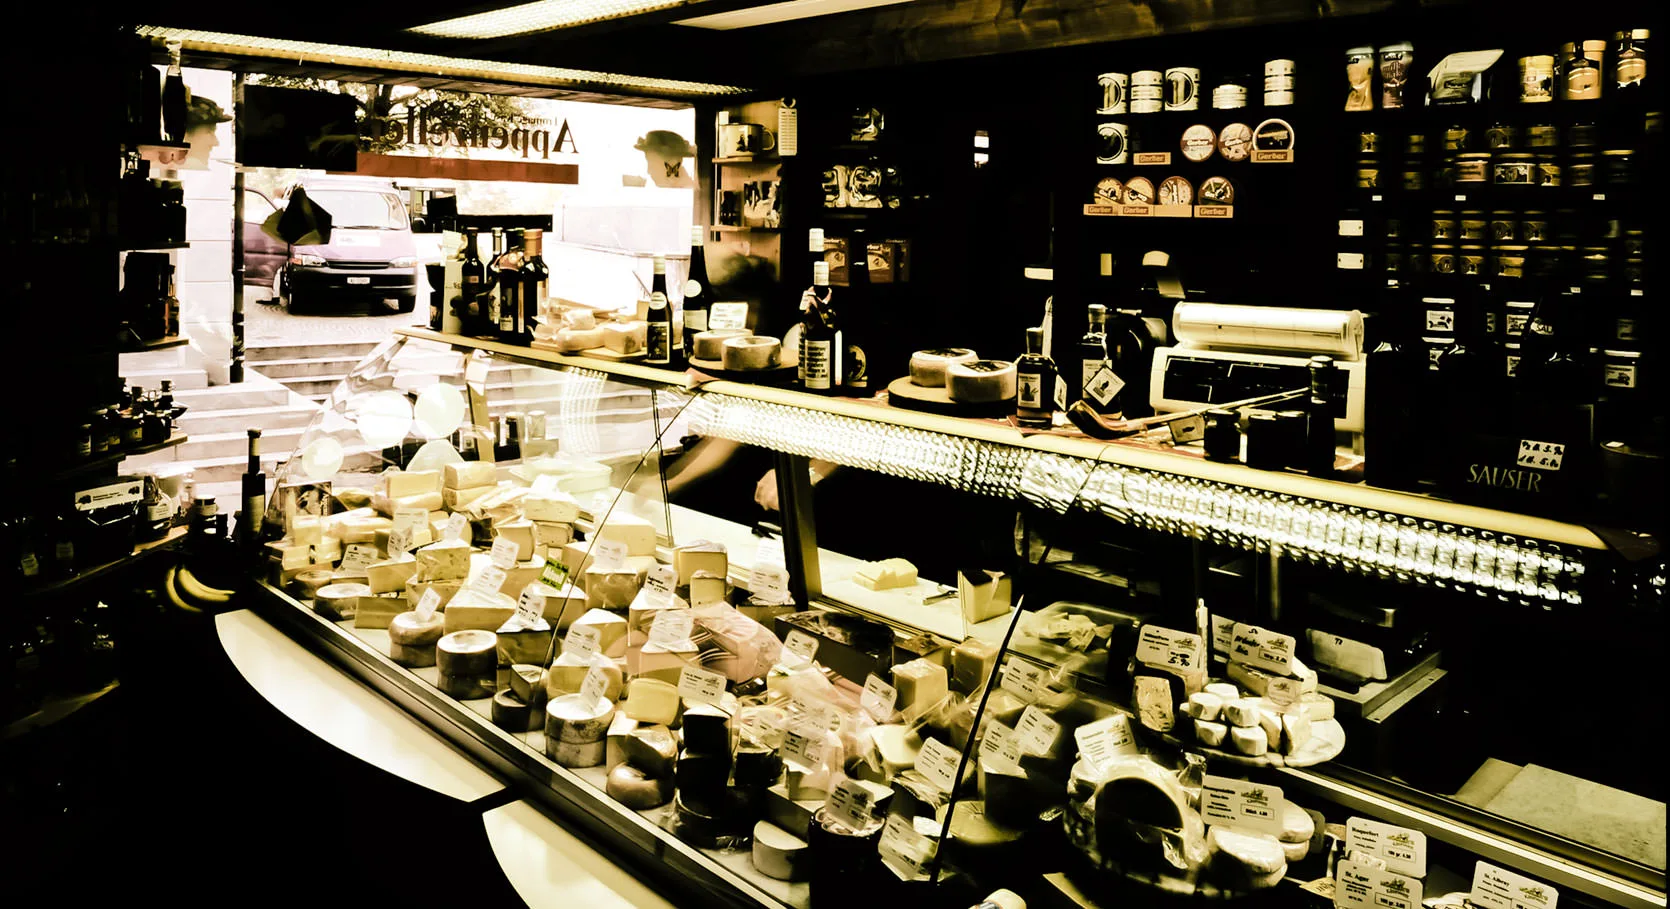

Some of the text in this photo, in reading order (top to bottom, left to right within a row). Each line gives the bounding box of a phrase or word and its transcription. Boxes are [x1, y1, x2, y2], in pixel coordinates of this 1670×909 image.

[1140, 155, 1165, 164] Gerber
[1256, 152, 1288, 162] Gerber
[1089, 206, 1113, 215] Gerber
[1124, 207, 1148, 216] Gerber
[1200, 207, 1227, 217] Gerber
[1467, 464, 1542, 493] SAUSER
